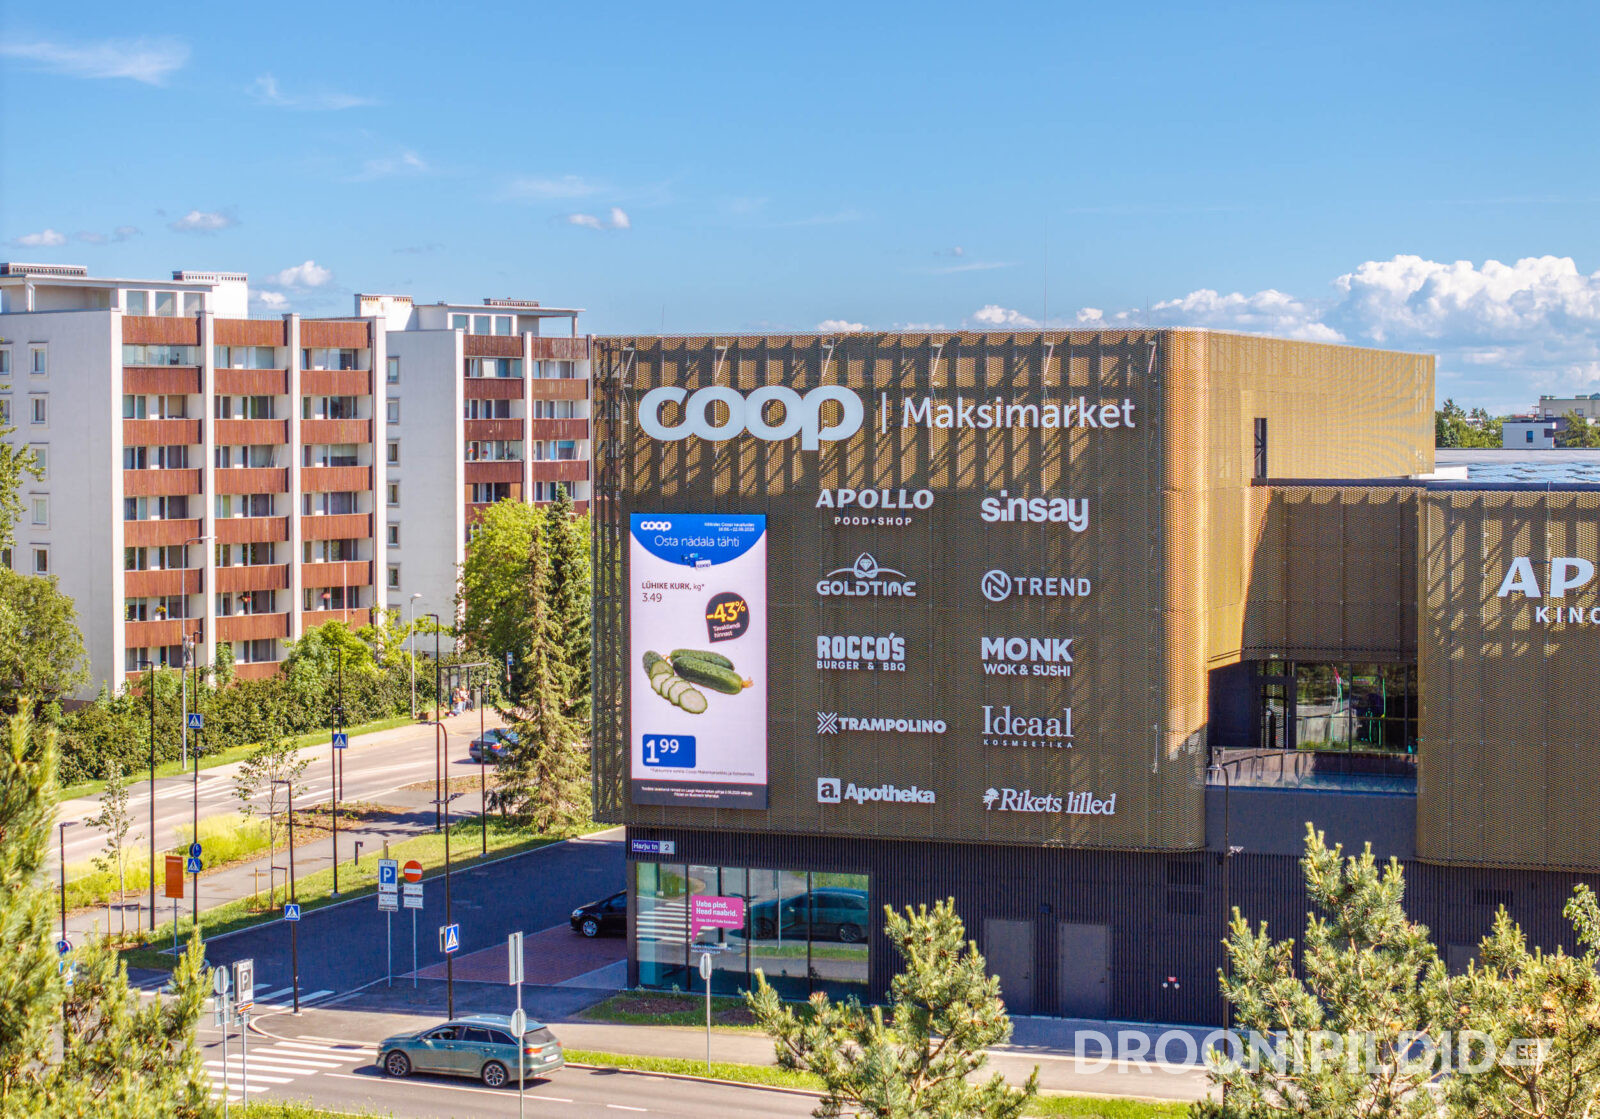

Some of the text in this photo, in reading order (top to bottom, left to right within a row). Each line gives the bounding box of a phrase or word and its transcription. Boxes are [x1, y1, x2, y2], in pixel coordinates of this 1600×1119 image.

[639, 386, 1136, 450] coop Maksimarket
[816, 489, 934, 510] APOLLO
[981, 490, 1089, 533] sinsay
[641, 521, 672, 532] coop
[654, 535, 740, 548] Osta nädala tähti
[641, 580, 668, 590] LÜHIKE
[669, 582, 692, 591] KURK,
[816, 580, 917, 597] GOLDTIME
[1015, 578, 1091, 597] TREND
[706, 600, 746, 623] -43%
[982, 636, 1074, 662] MONK
[816, 660, 906, 673] BURGER & BBQ
[983, 663, 1071, 677] WOK & SUSHI
[839, 717, 947, 734] TRAMPOLINO
[982, 705, 1074, 738] Ideaal
[983, 738, 1073, 748] KOSMEETIKA
[844, 784, 936, 805] Apotheka
[998, 788, 1117, 816] Rikets lilled
[633, 842, 650, 851] Harju
[383, 867, 392, 882] P
